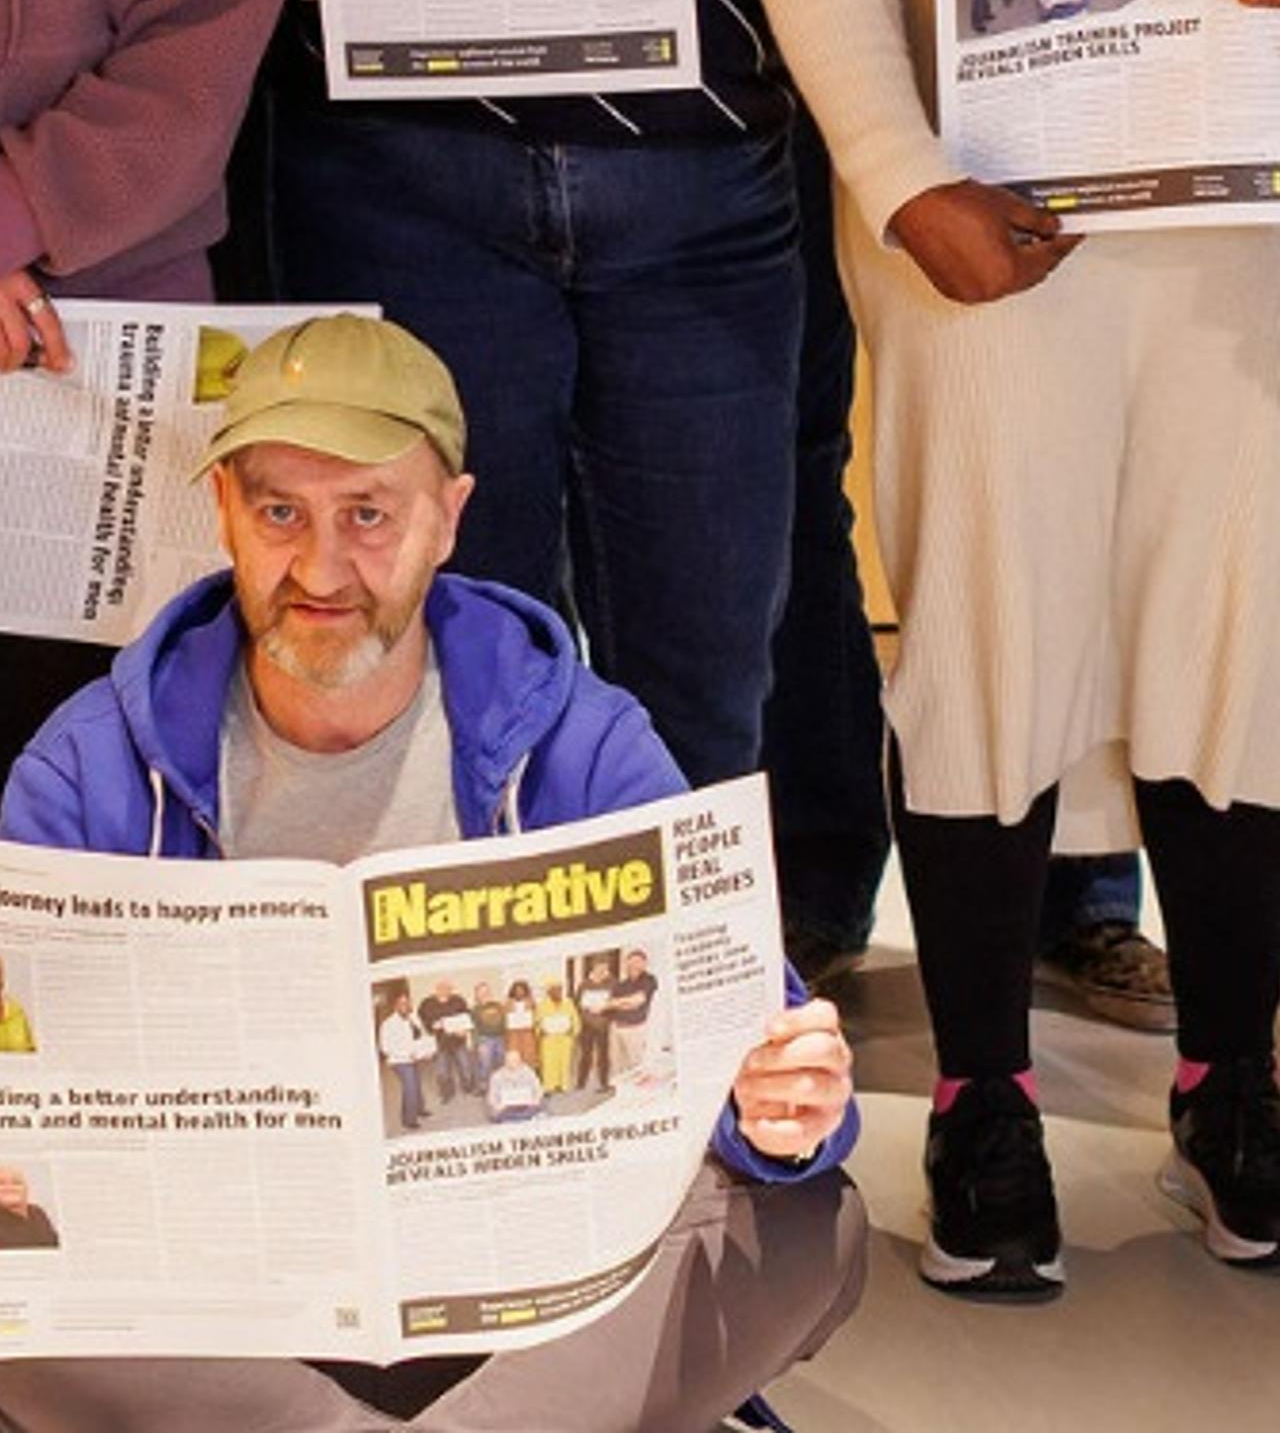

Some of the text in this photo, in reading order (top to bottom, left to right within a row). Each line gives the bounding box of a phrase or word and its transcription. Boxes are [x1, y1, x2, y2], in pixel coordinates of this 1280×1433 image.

[961, 17, 1201, 66] JOURNALISM TRAINING PROJECT
[956, 40, 1141, 82] REVEALS HIDDEN SKILLS
[673, 810, 716, 838] REAL
[675, 824, 742, 861] PEOPLE
[677, 857, 722, 884] REAL
[680, 868, 755, 907] STORIES
[71, 893, 123, 919] leads
[129, 899, 150, 920] to
[157, 899, 222, 924] happy
[228, 899, 329, 920] memories
[387, 859, 653, 942] Narrative
[48, 1091, 62, 1106] a
[67, 1088, 138, 1106] better
[40, 1112, 82, 1130] and
[88, 1112, 167, 1130] mental
[174, 1111, 249, 1130] health
[255, 1111, 286, 1129] for
[293, 1114, 343, 1130] men
[388, 1116, 680, 1170] JOURNALISM TRAINING PROJECT
[386, 1145, 609, 1186] REVEALS HIDDEN SKILLS
